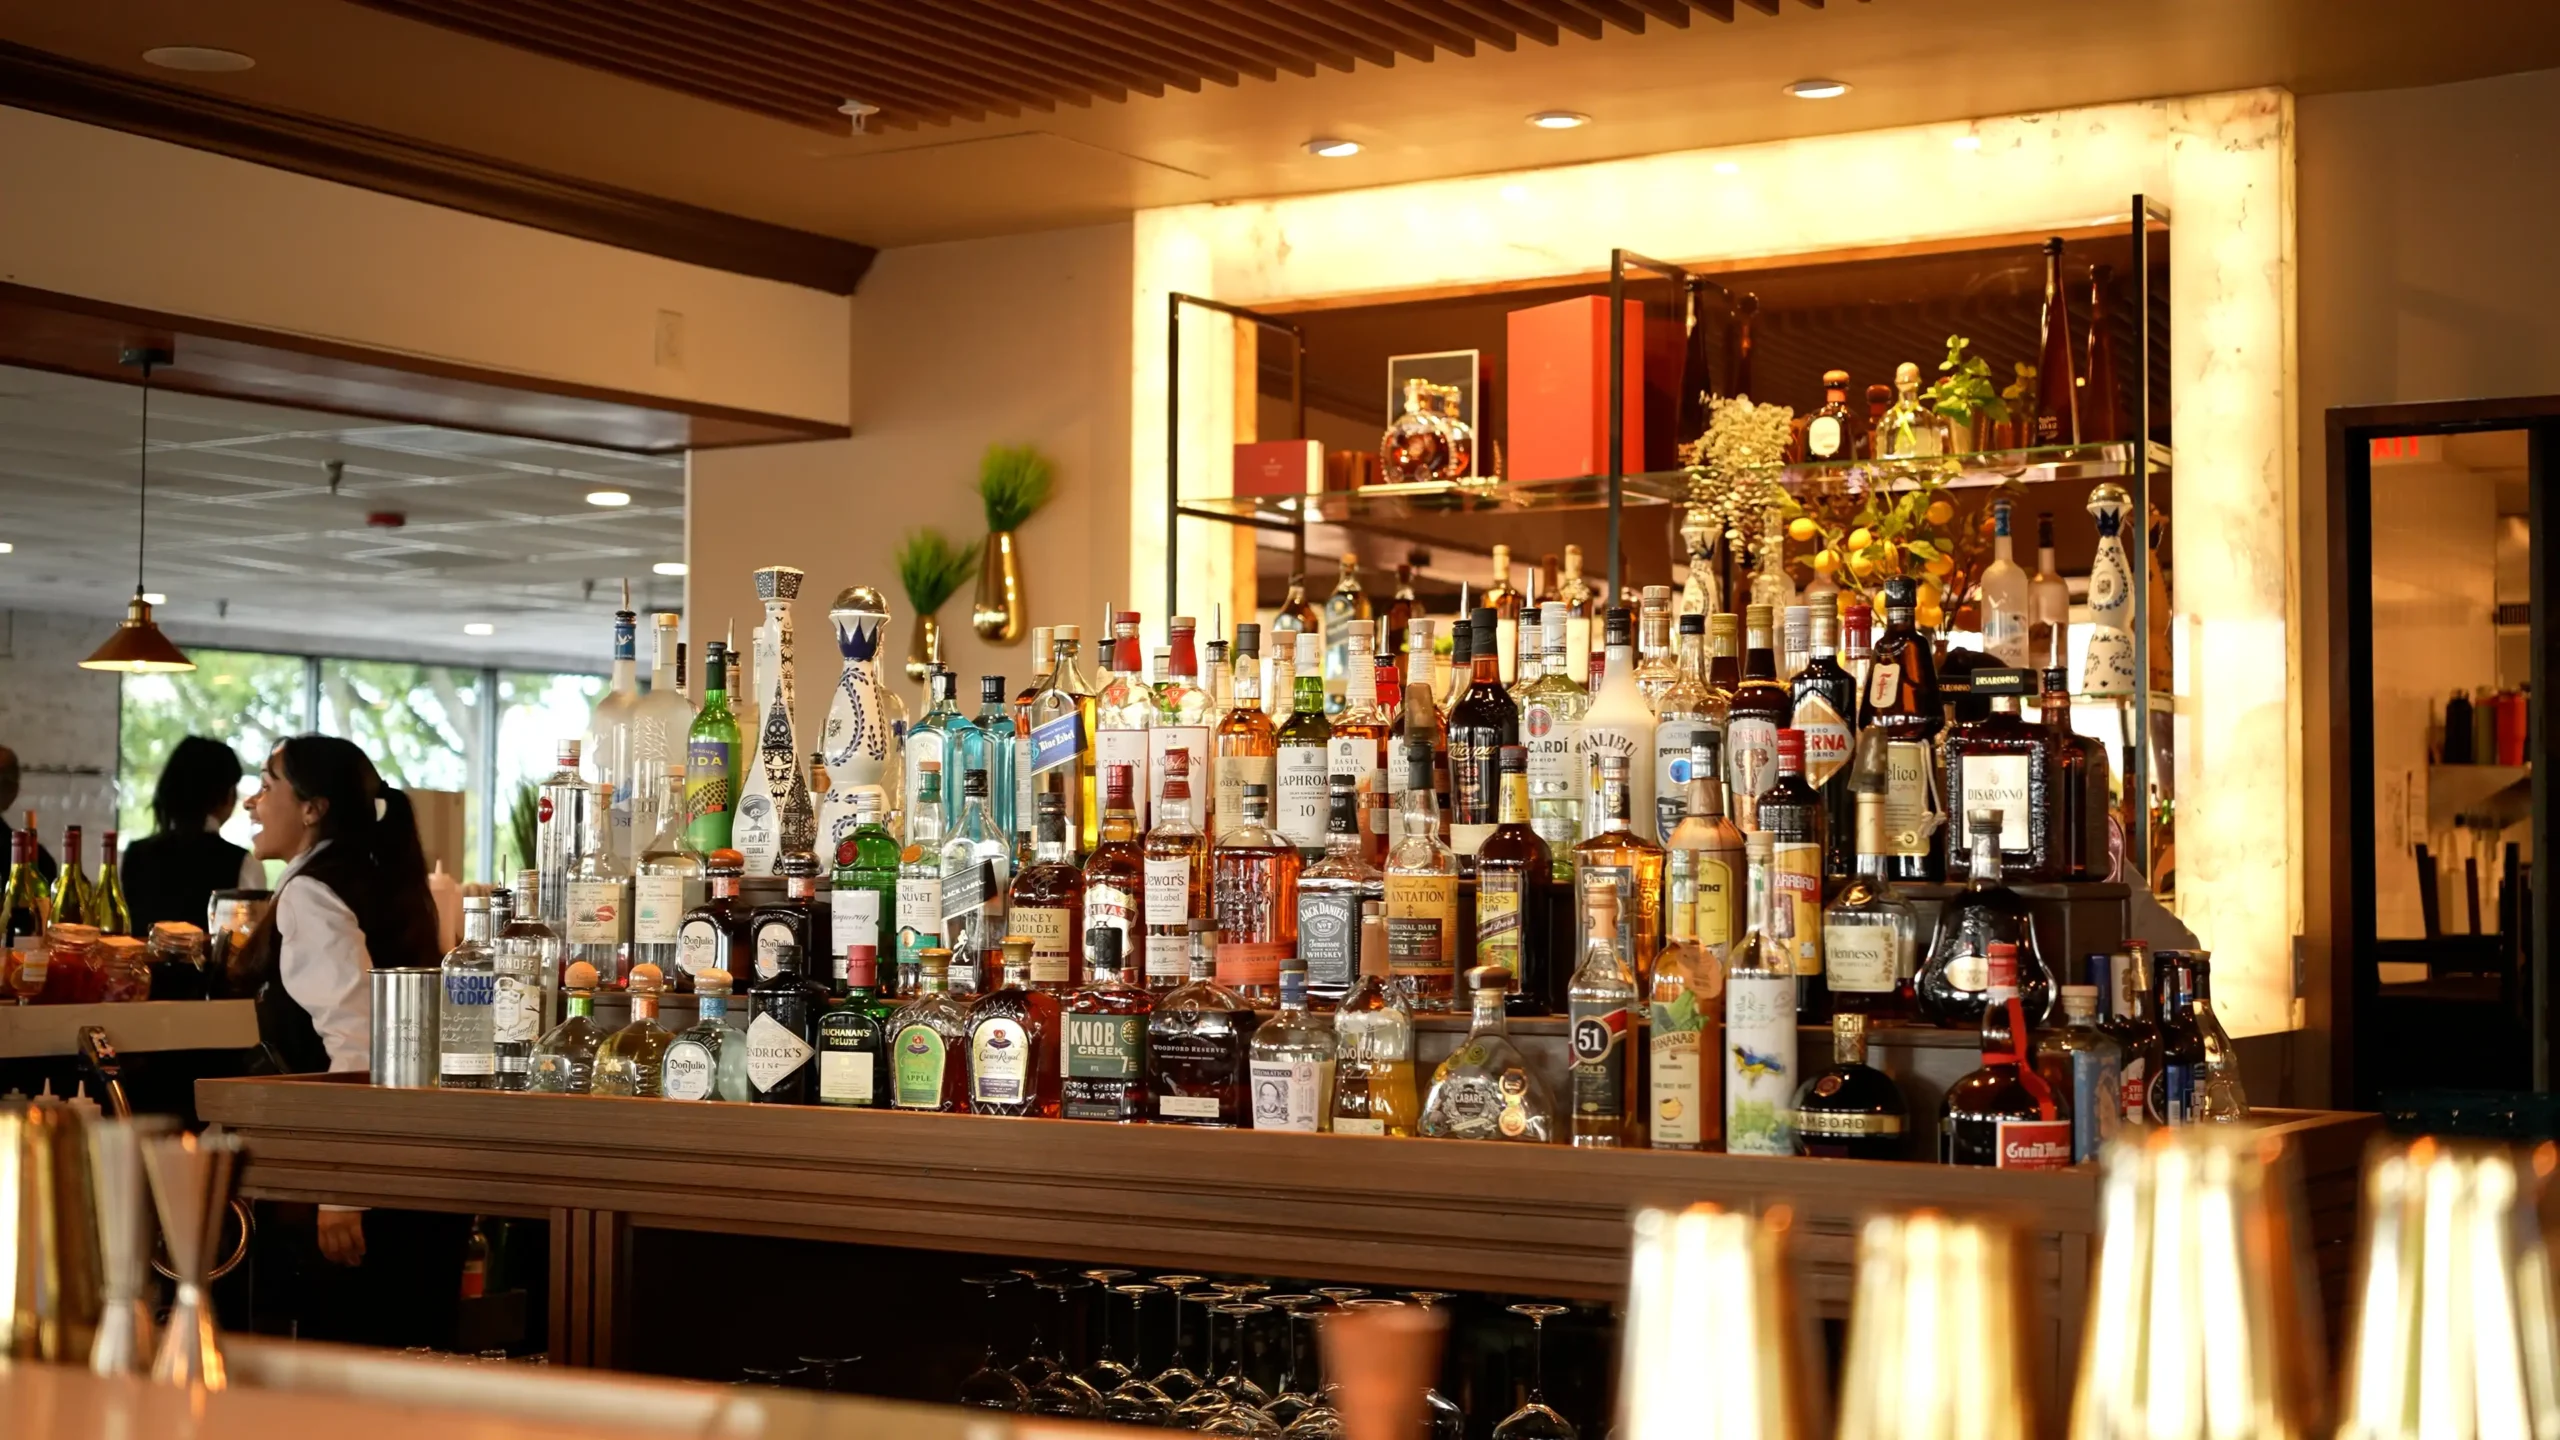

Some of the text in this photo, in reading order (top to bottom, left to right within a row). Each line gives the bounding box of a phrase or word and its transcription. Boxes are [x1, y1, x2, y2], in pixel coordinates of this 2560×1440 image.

[2373, 436, 2419, 457] XIT
[1975, 676, 2019, 685] DISARONNO
[1939, 684, 1971, 692] SARONNO
[1038, 730, 1075, 752] Blue Label
[1519, 737, 1568, 753] CARDÍ
[1581, 733, 1638, 757] MALIBU
[1805, 734, 1848, 750] ERNA
[1659, 747, 1691, 758] germa
[1096, 759, 1141, 768] CALLAN
[1151, 757, 1202, 766] MACAN
[1887, 765, 1917, 781] elico
[1279, 775, 1328, 786] LAPHROA
[1967, 788, 2024, 801] DISARONNO
[1300, 804, 1316, 817] 10
[612, 817, 632, 827] OSE
[758, 832, 770, 842] AY!
[1144, 873, 1185, 886] Dewar's
[1774, 874, 1815, 891] ARREIRO
[942, 880, 984, 900] LACK LABEL
[899, 892, 932, 902] NLIVET
[1160, 893, 1180, 901] Label
[1392, 891, 1445, 902] ANTATION
[902, 904, 913, 914] 12
[1300, 902, 1349, 922] JACK DANIEL'S
[832, 911, 870, 923] anqueray
[1010, 913, 1053, 922] MONKEY
[1010, 925, 1059, 933] HOULDER
[683, 935, 714, 948] Don Julio
[760, 938, 775, 948] Don
[1308, 939, 1340, 948] Tennessee
[1830, 948, 1878, 962] Hennessy
[495, 959, 534, 971] IRNOFF
[954, 968, 964, 977] 12
[445, 976, 494, 990] ABSOLU
[448, 991, 494, 1005] VODKA
[821, 1028, 870, 1037] BUCHANAN'S
[1070, 1021, 1115, 1046] KNOB
[830, 1037, 860, 1046] DeLUXE
[1578, 1028, 1602, 1051] 51
[747, 1047, 802, 1058] ENDRICK'S
[1077, 1046, 1125, 1055] CREEK
[979, 1050, 1020, 1064] Crown Royal
[670, 1059, 705, 1073] Don Julio
[1120, 1056, 1128, 1073] 7
[1577, 1065, 1607, 1073] GOLD
[1799, 1117, 1866, 1129] AMBORD
